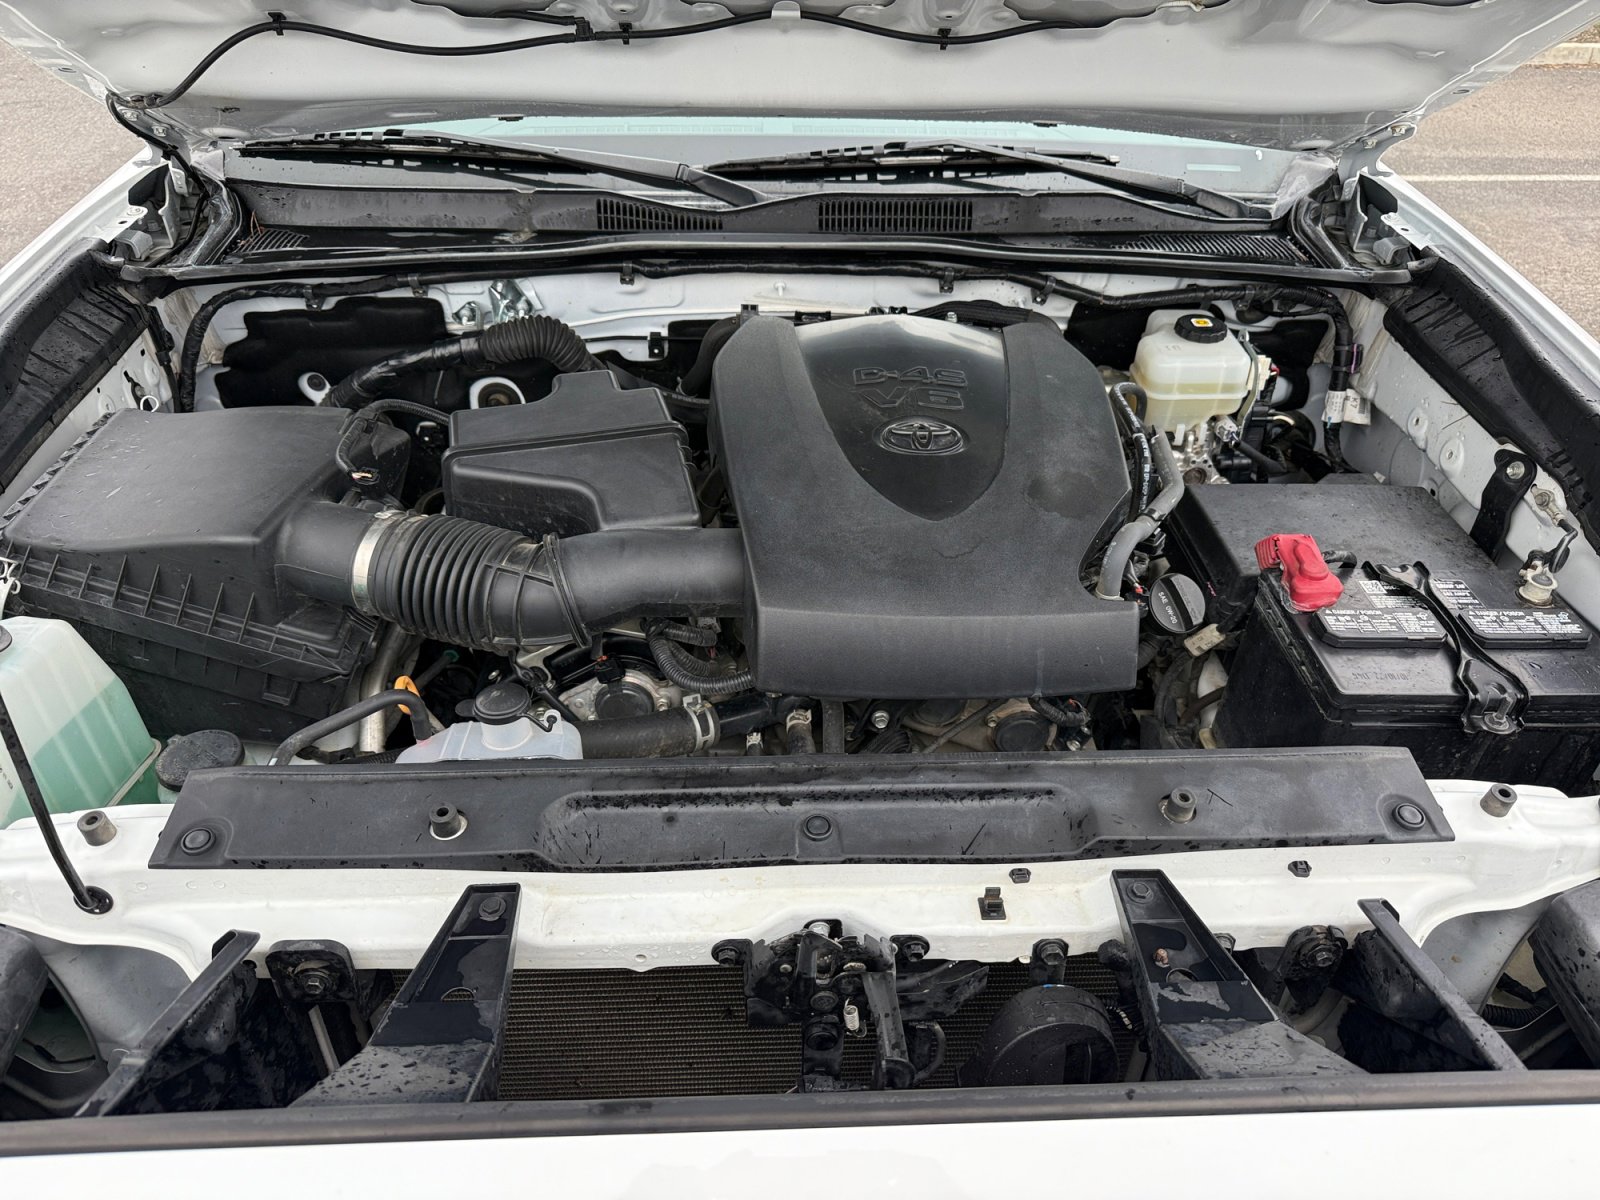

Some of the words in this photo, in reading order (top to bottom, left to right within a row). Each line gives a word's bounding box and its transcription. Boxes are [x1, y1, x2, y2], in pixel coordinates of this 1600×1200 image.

[853, 366, 968, 387] D-4S
[851, 386, 964, 410] V6
[1158, 591, 1168, 604] SAE
[1165, 605, 1178, 624] 0W-20
